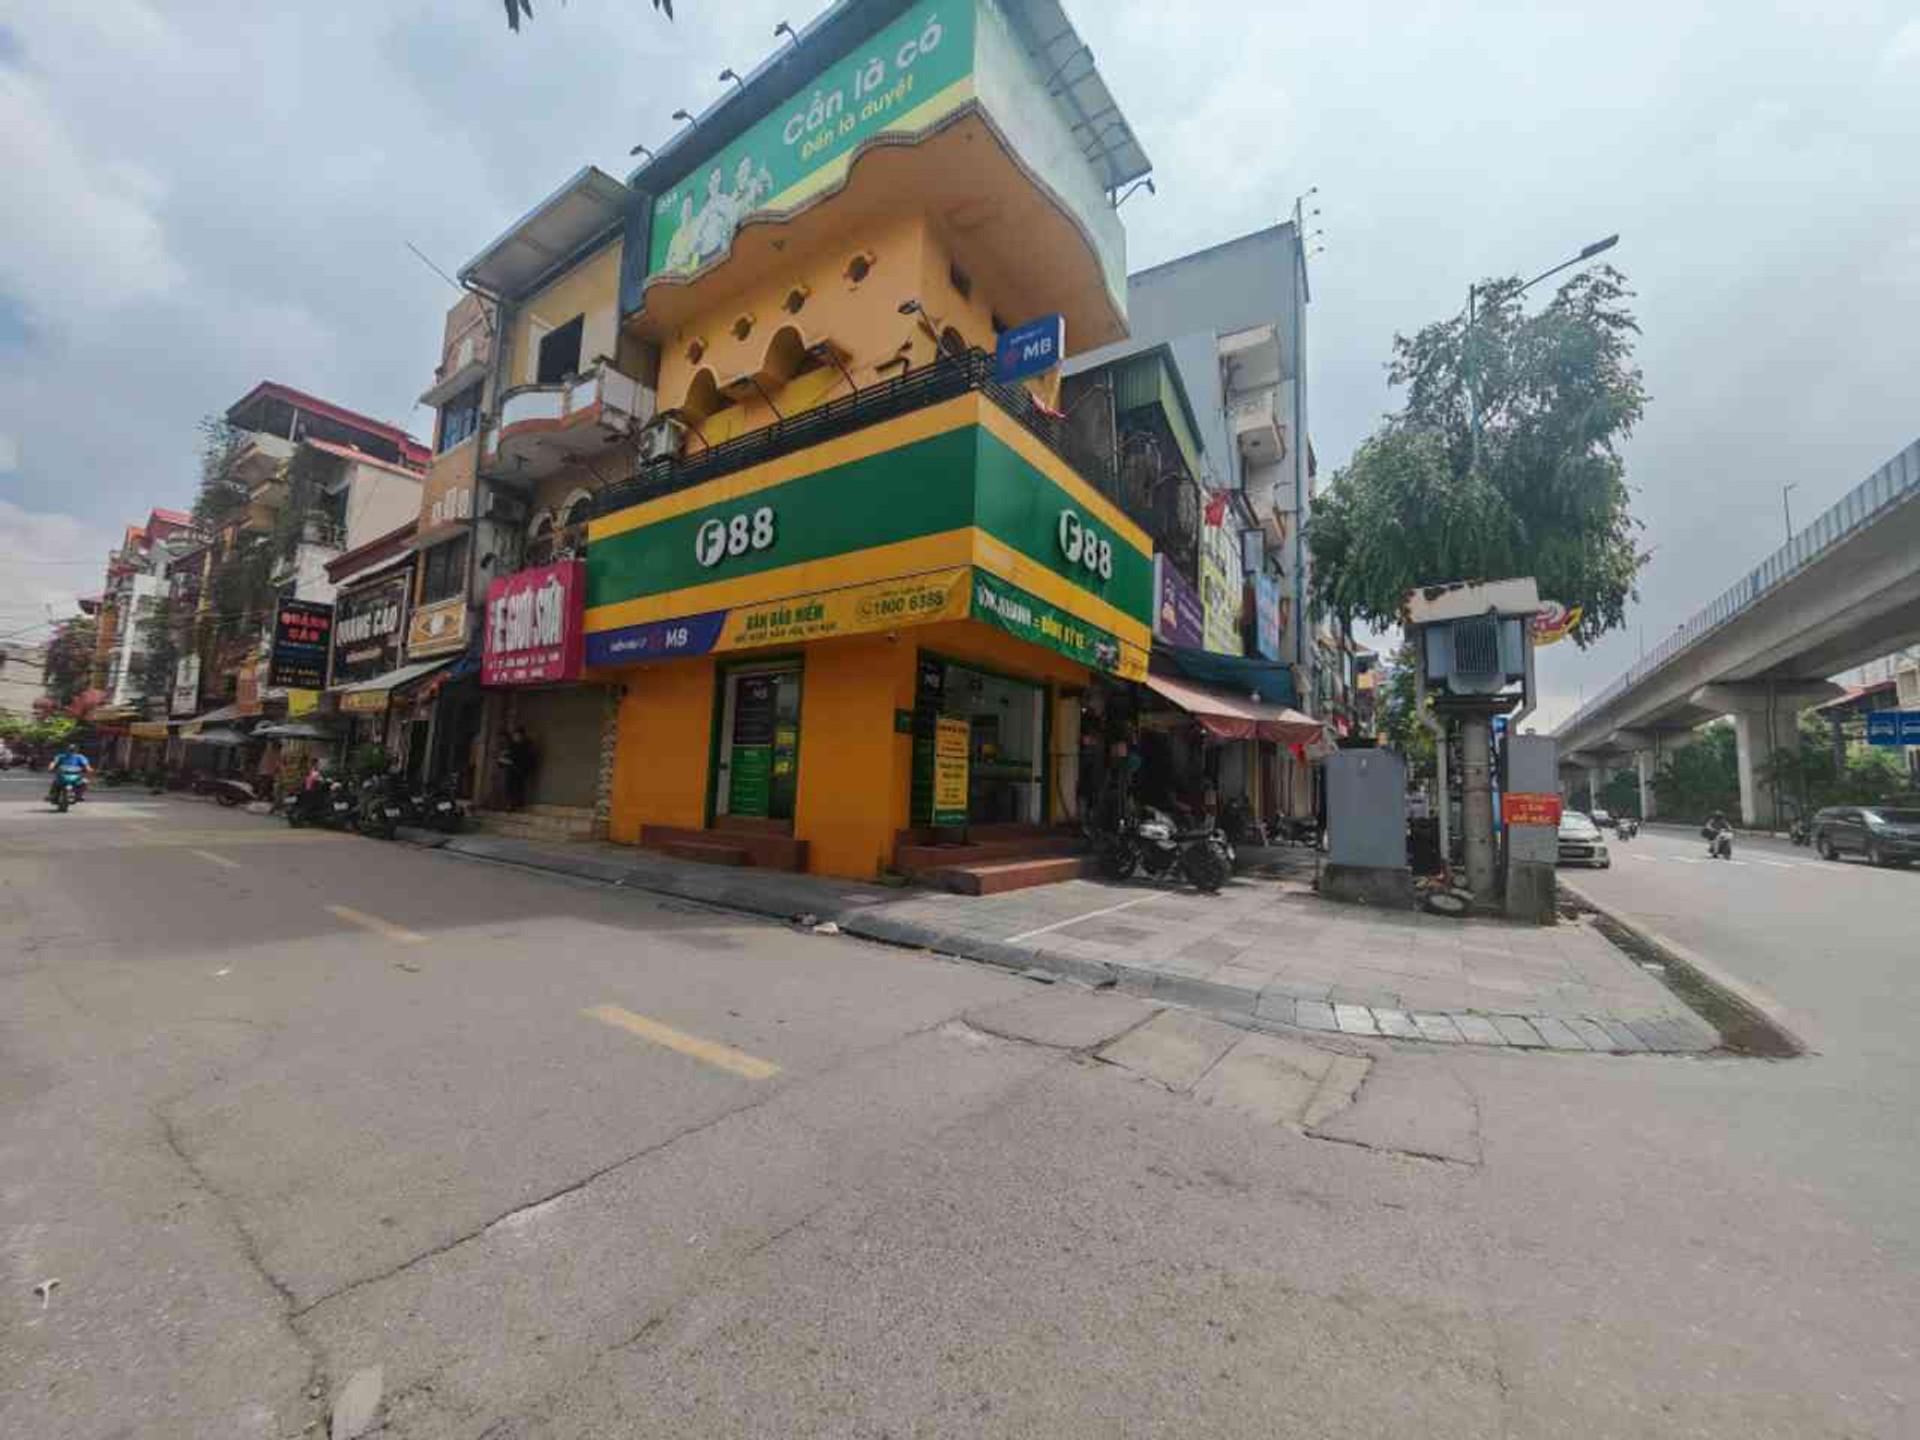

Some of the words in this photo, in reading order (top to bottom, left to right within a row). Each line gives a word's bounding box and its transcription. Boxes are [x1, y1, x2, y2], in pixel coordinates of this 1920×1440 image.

[854, 57, 885, 100] là
[896, 13, 942, 69] có
[1023, 337, 1052, 361] MB
[695, 506, 774, 567] F88
[1059, 509, 1112, 579] F88
